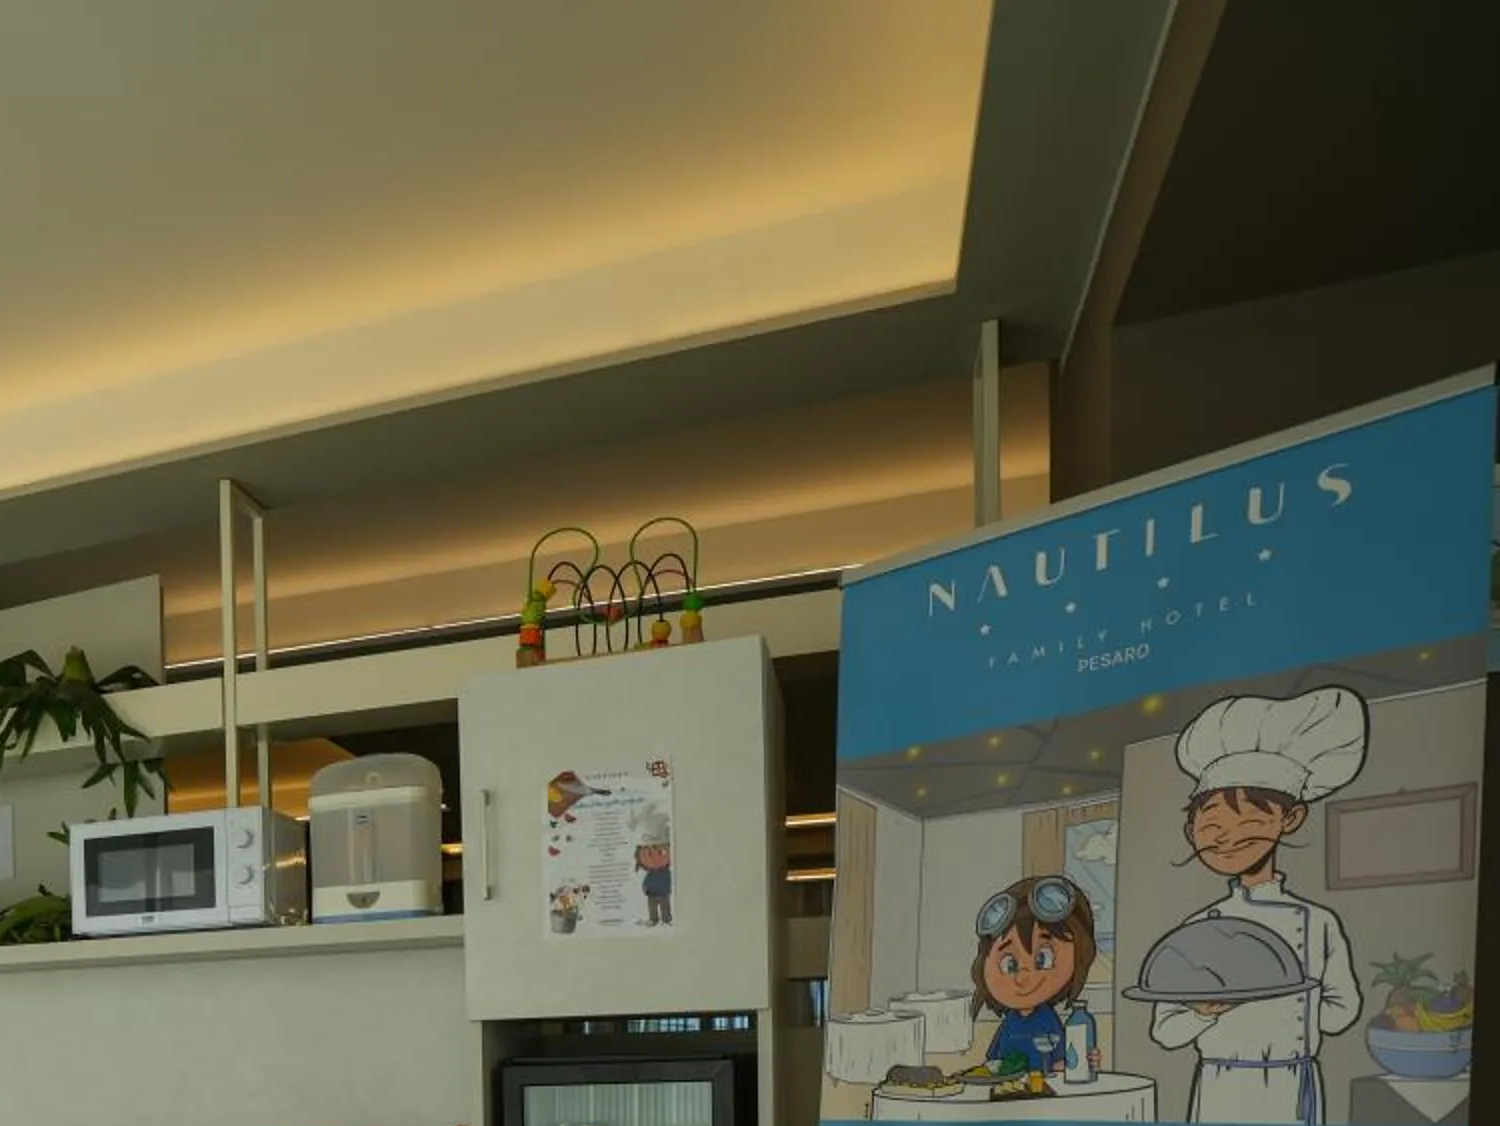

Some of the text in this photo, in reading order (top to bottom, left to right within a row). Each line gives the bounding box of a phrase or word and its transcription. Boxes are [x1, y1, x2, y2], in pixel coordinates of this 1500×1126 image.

[928, 463, 1353, 617] NAUTILUS
[988, 592, 1258, 670] FAMILY HOTEL
[1077, 643, 1150, 673] PESARO
